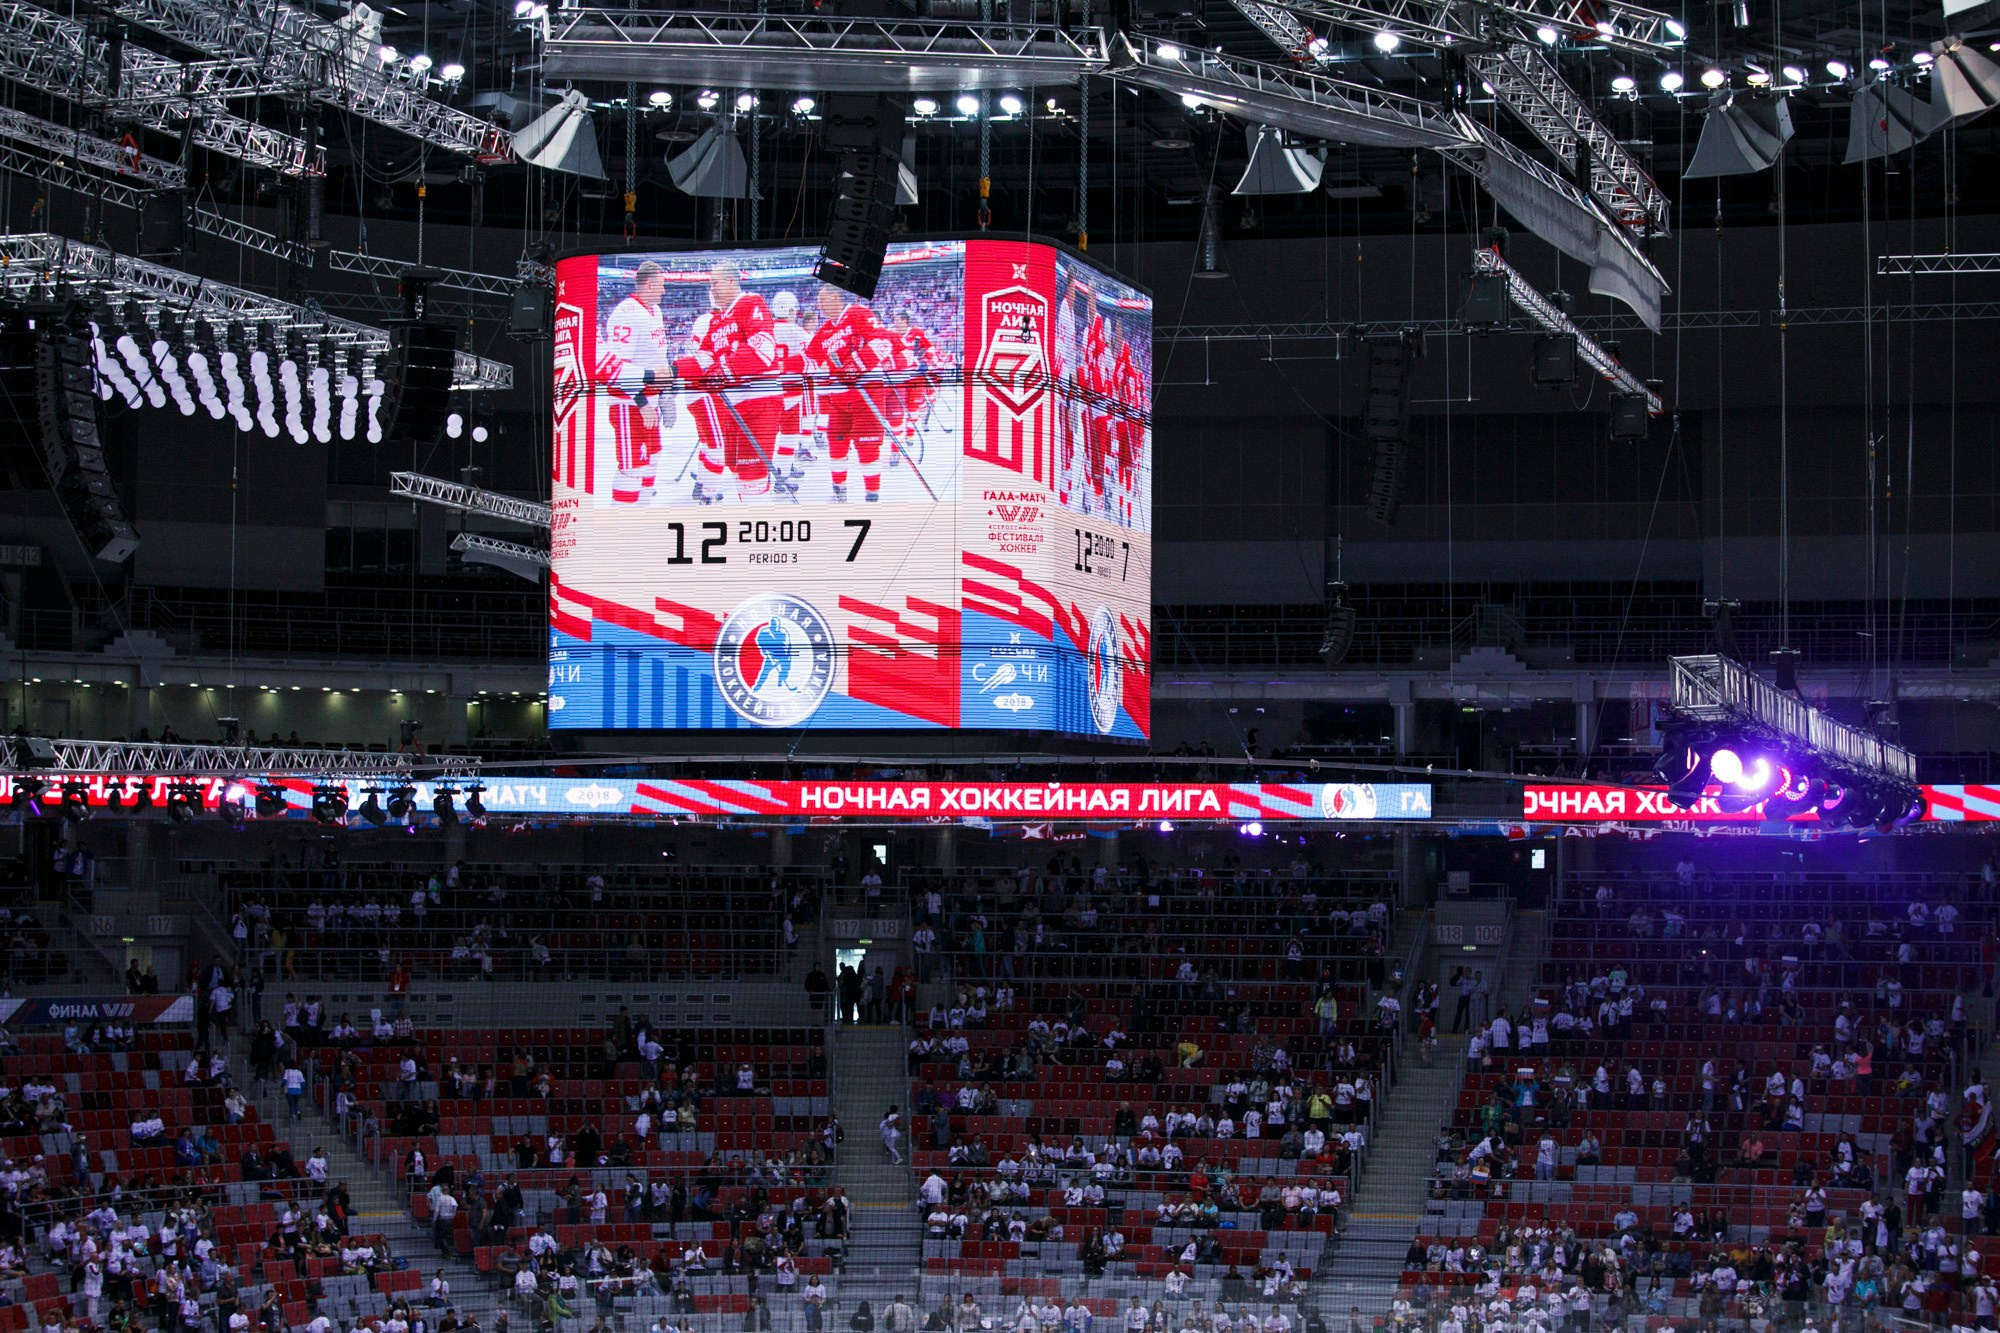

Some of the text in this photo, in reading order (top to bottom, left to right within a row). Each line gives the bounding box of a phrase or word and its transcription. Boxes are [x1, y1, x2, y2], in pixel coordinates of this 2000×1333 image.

[991, 301, 1044, 317] НОЧНАЯ
[612, 326, 633, 343] 52
[983, 490, 1046, 504] ГАЛА-МАТЧ
[739, 520, 811, 542] 20:00
[988, 533, 1044, 543] ФЕСТИВАЛЯ
[667, 522, 727, 565] 12
[844, 519, 872, 562] 7
[1000, 544, 1037, 553] ХОККЕЯ
[1075, 528, 1092, 573] 12
[749, 553, 798, 563] PERIOD 3
[1122, 541, 1129, 581] 7
[1003, 698, 1026, 706] 2018
[578, 791, 610, 800] 2018
[801, 782, 1221, 812] НОЧНАЯ ХОККЕЙНАЯ ЛИГА
[151, 917, 170, 931] 117
[837, 921, 858, 935] 117
[874, 921, 897, 935] 118
[1439, 926, 1460, 940] 118
[1476, 926, 1500, 941] 100
[48, 1002, 99, 1019] ФИНАЛ
